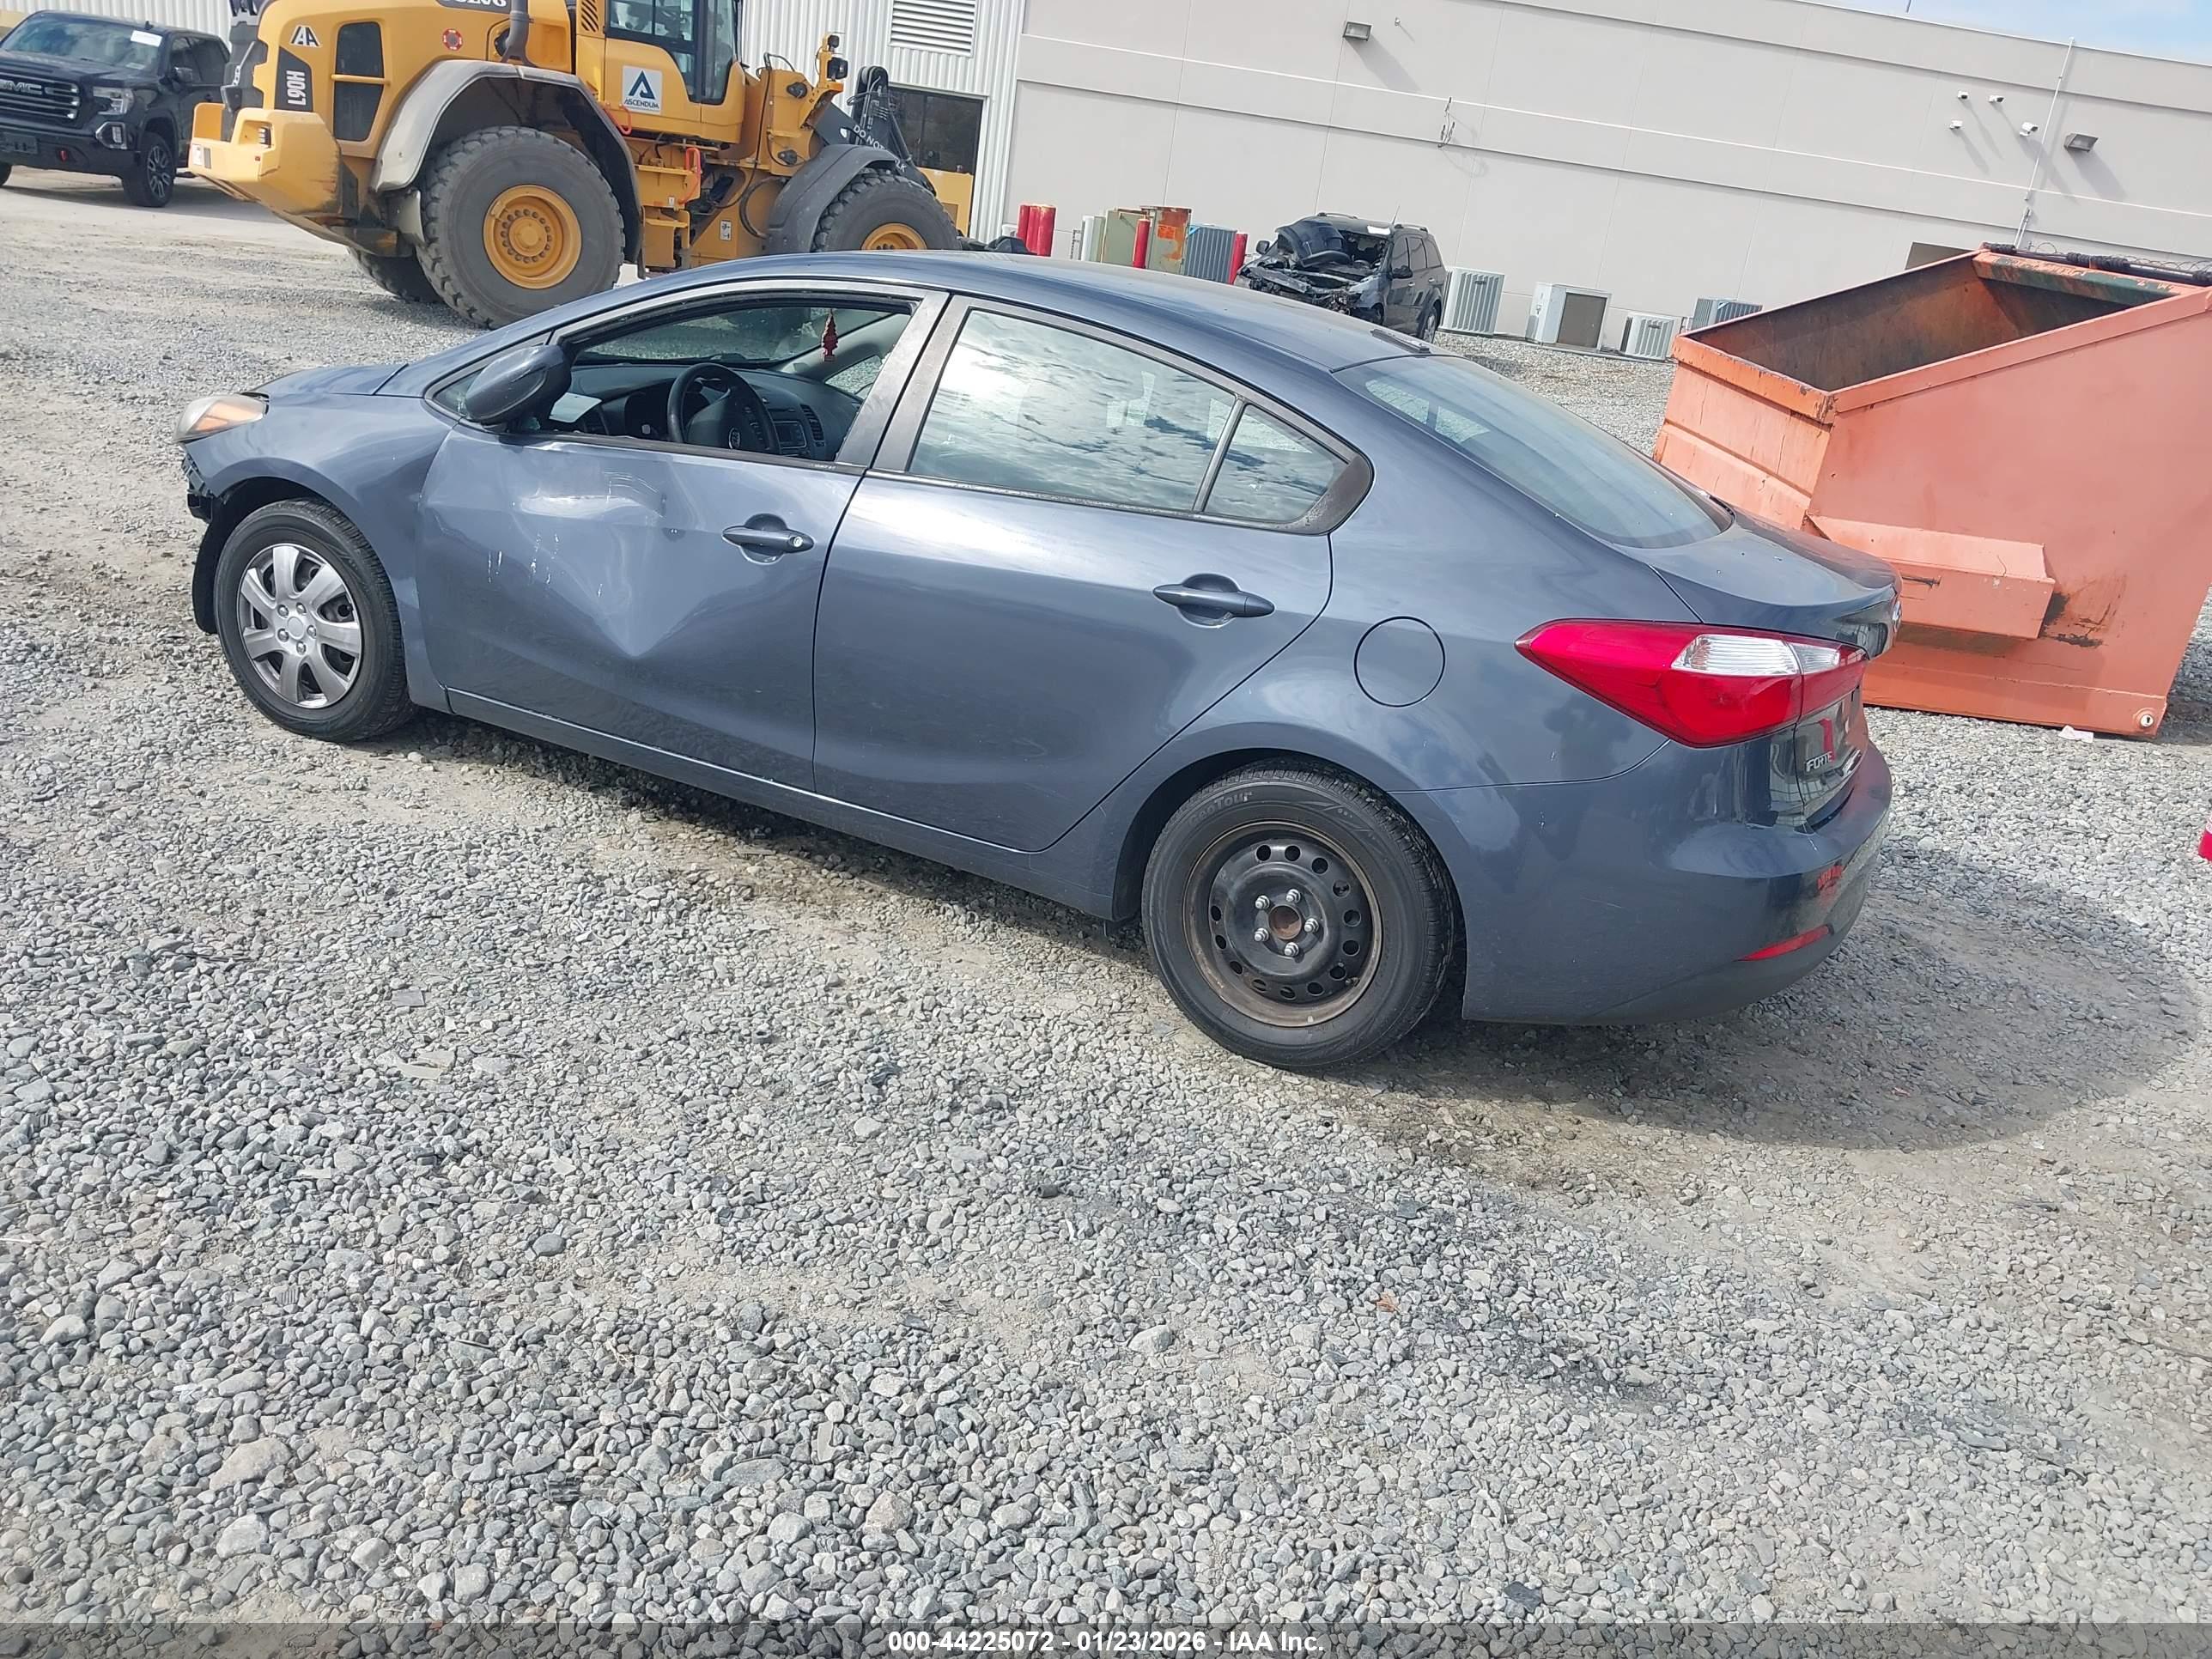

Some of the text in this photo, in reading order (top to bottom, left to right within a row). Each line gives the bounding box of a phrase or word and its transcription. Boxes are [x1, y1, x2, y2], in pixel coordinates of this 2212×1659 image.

[286, 70, 307, 106] L90H
[624, 97, 659, 109] ASCENDUM
[853, 125, 866, 138] DO
[1806, 750, 1832, 772] FORTE
